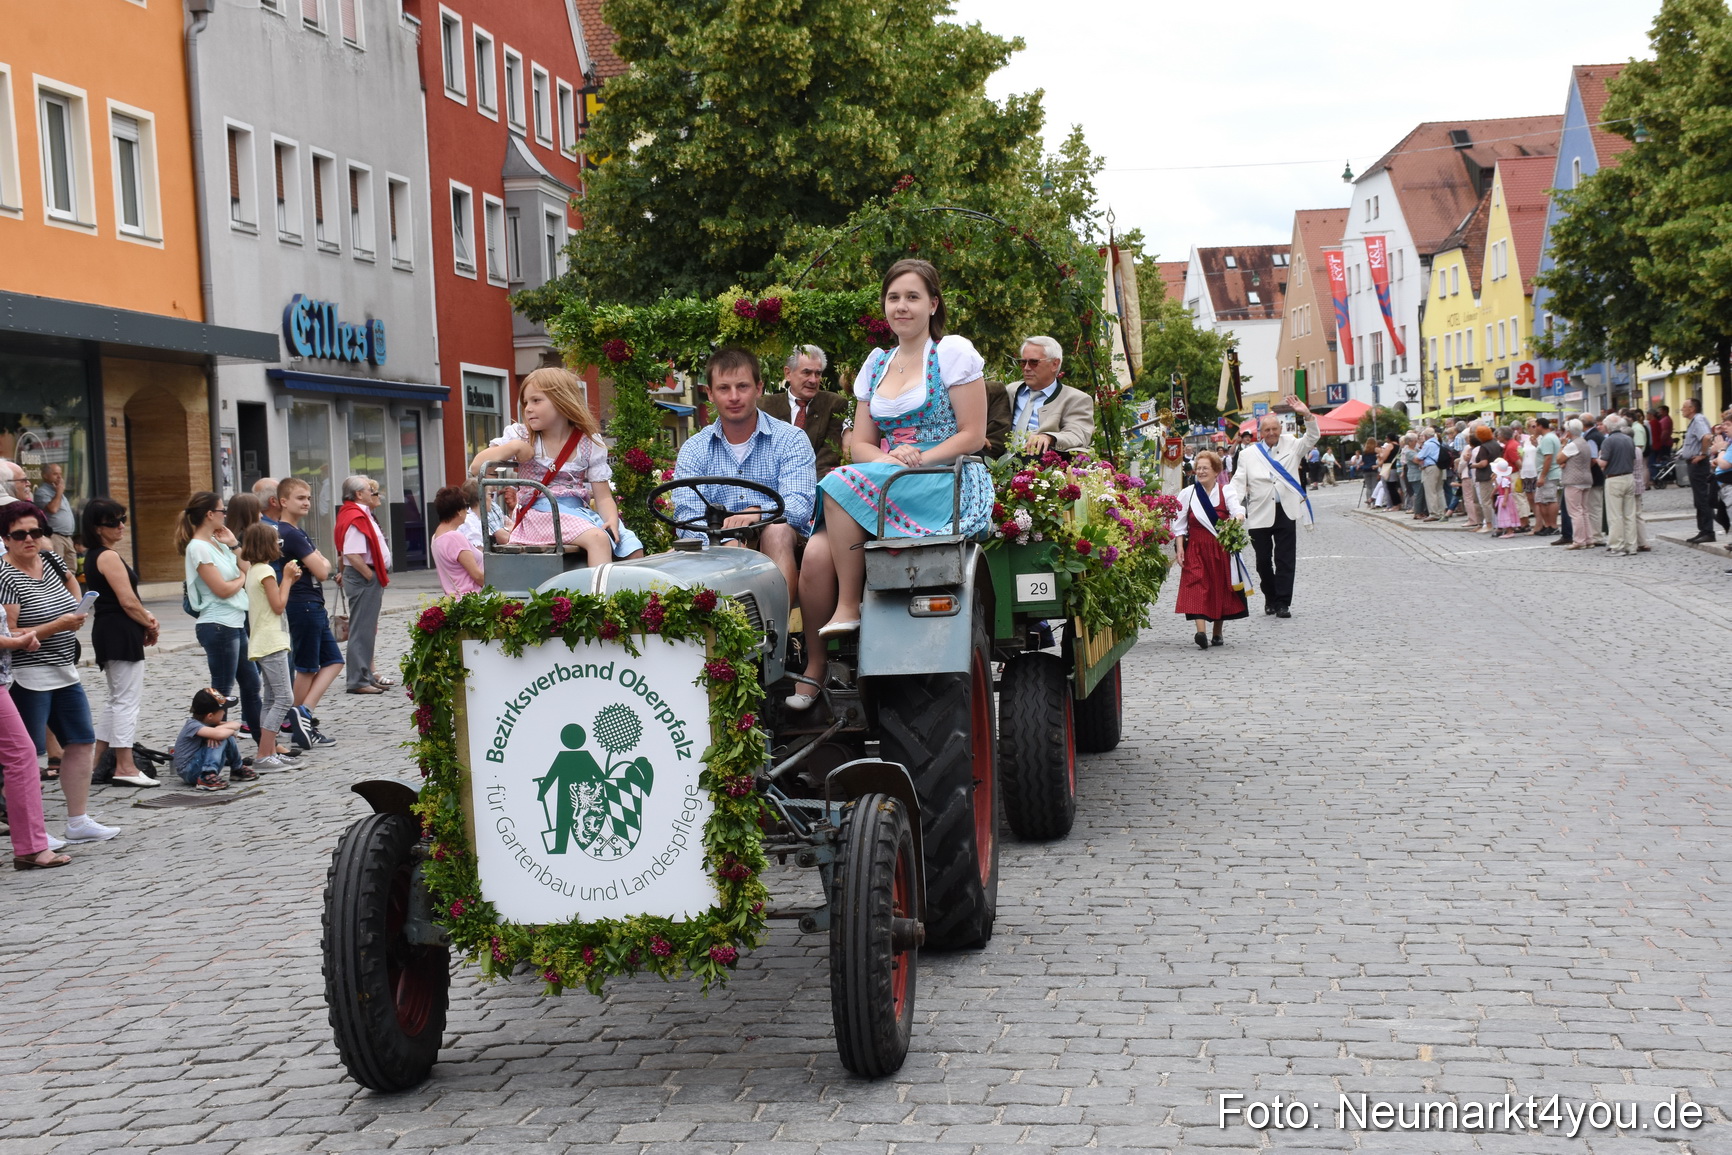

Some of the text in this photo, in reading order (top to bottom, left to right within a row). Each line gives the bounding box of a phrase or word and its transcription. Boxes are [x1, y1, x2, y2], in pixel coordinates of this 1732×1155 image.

[1368, 239, 1381, 269] K&L
[289, 293, 368, 363] Eilles
[1030, 582, 1048, 596] 29
[486, 661, 694, 764] Bezirksverband Oberpfalz
[486, 784, 704, 901] für Gartenbau und Landespflege
